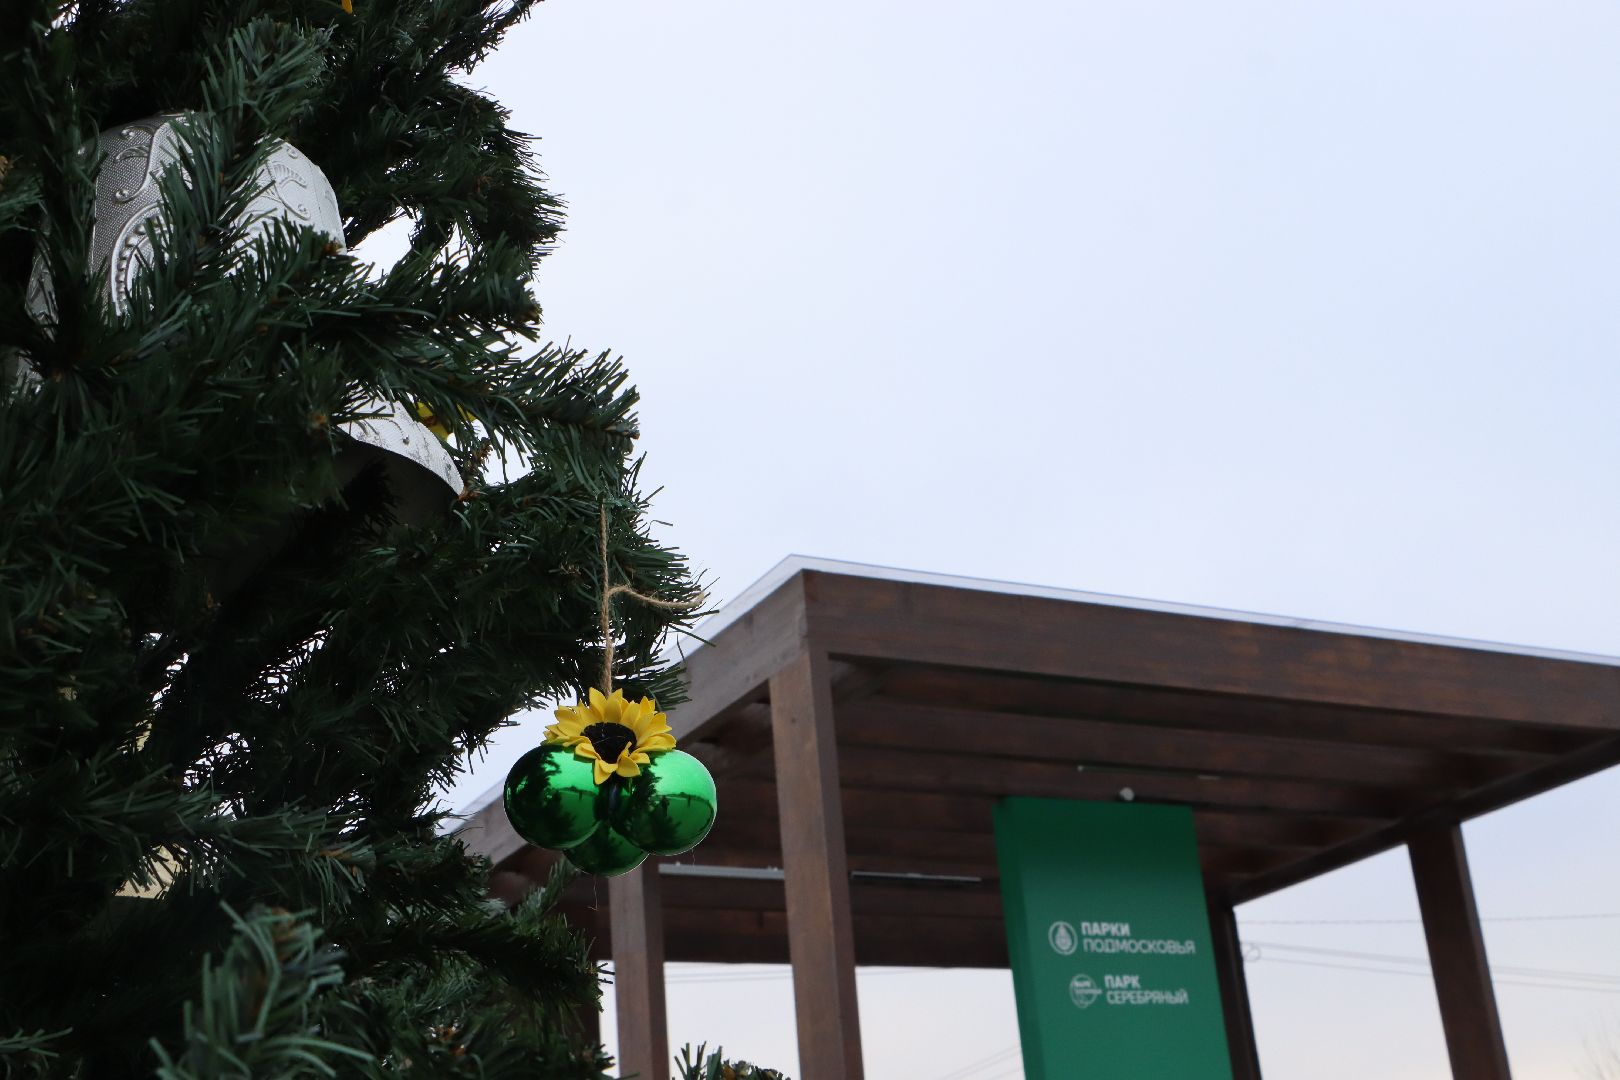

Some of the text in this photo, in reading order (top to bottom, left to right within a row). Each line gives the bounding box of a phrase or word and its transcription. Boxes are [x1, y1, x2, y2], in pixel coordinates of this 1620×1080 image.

[1081, 922, 1131, 936] ПАРКИ
[1083, 938, 1196, 954] ПОДМОСКОВЬЯ
[1104, 975, 1141, 988] ПАРК
[1106, 989, 1189, 1004] СЕРЕБРЯНЫЙ
